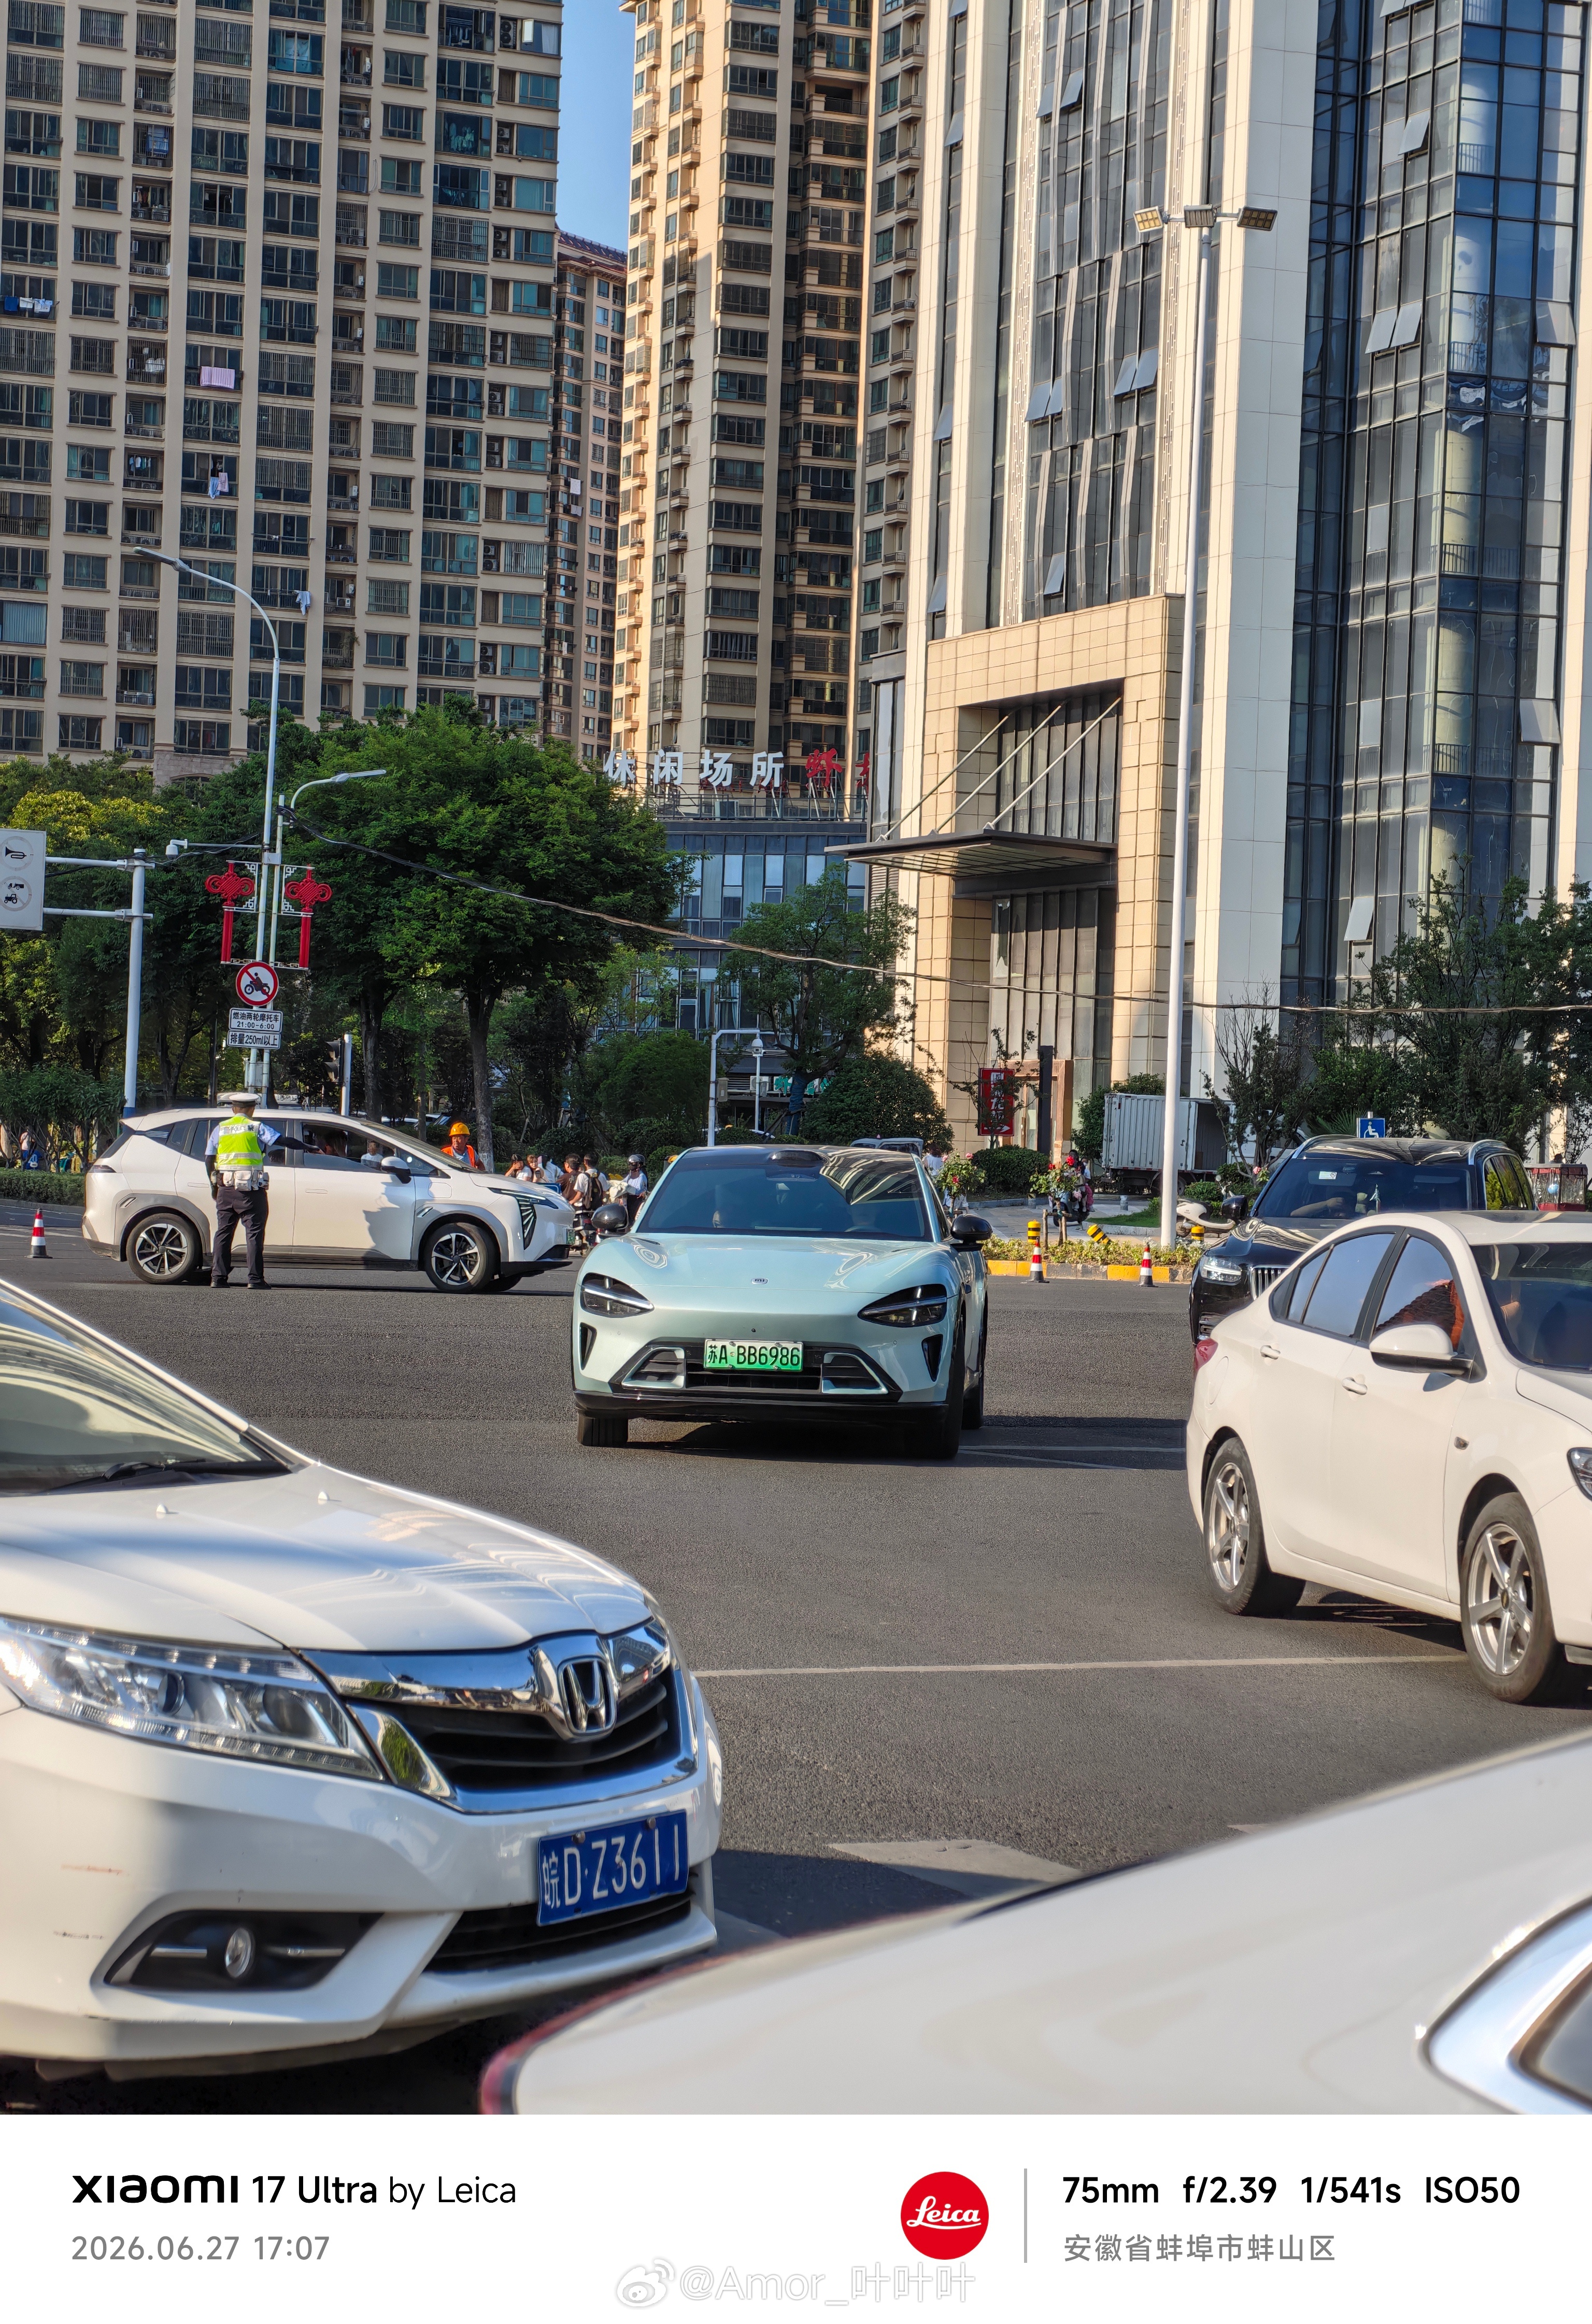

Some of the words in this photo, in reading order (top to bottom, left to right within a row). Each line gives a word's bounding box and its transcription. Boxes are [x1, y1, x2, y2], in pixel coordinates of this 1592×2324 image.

[603, 748, 784, 787] 休闲场所
[233, 1011, 280, 1023] 燃油两轮摩托车
[237, 1021, 275, 1030] 21:00-6:00
[230, 1032, 278, 1046] 排量250ml以上
[542, 1824, 679, 1909] 皖D·Z3611
